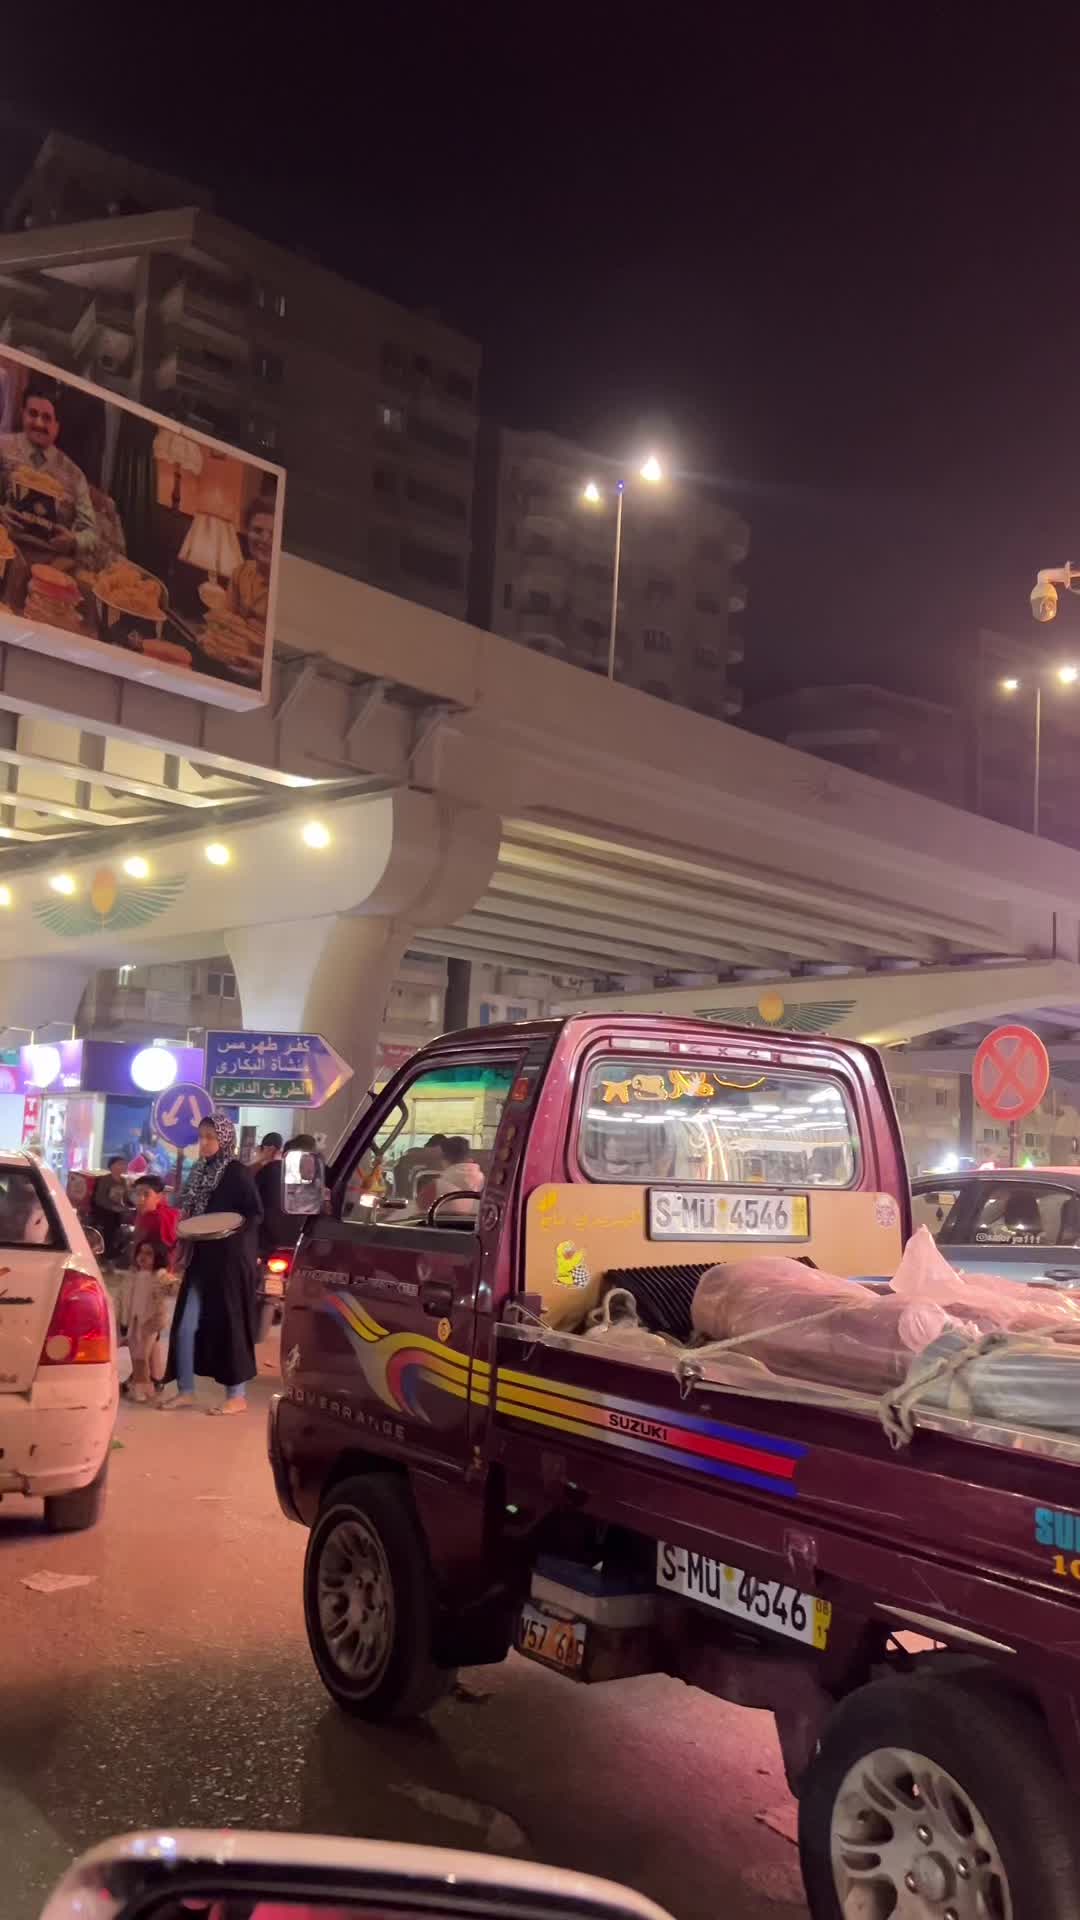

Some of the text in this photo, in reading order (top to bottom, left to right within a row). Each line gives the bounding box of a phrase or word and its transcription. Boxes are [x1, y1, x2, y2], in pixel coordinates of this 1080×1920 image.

[218, 1036, 310, 1056] كفر طهرمس
[271, 1056, 311, 1073] منشأة
[262, 1081, 306, 1099] لطريق
[655, 1196, 715, 1229] S-MÜ
[729, 1199, 789, 1231] 4546
[608, 1413, 668, 1441] SUZUKI
[661, 1543, 807, 1632] S-MÜ 4546
